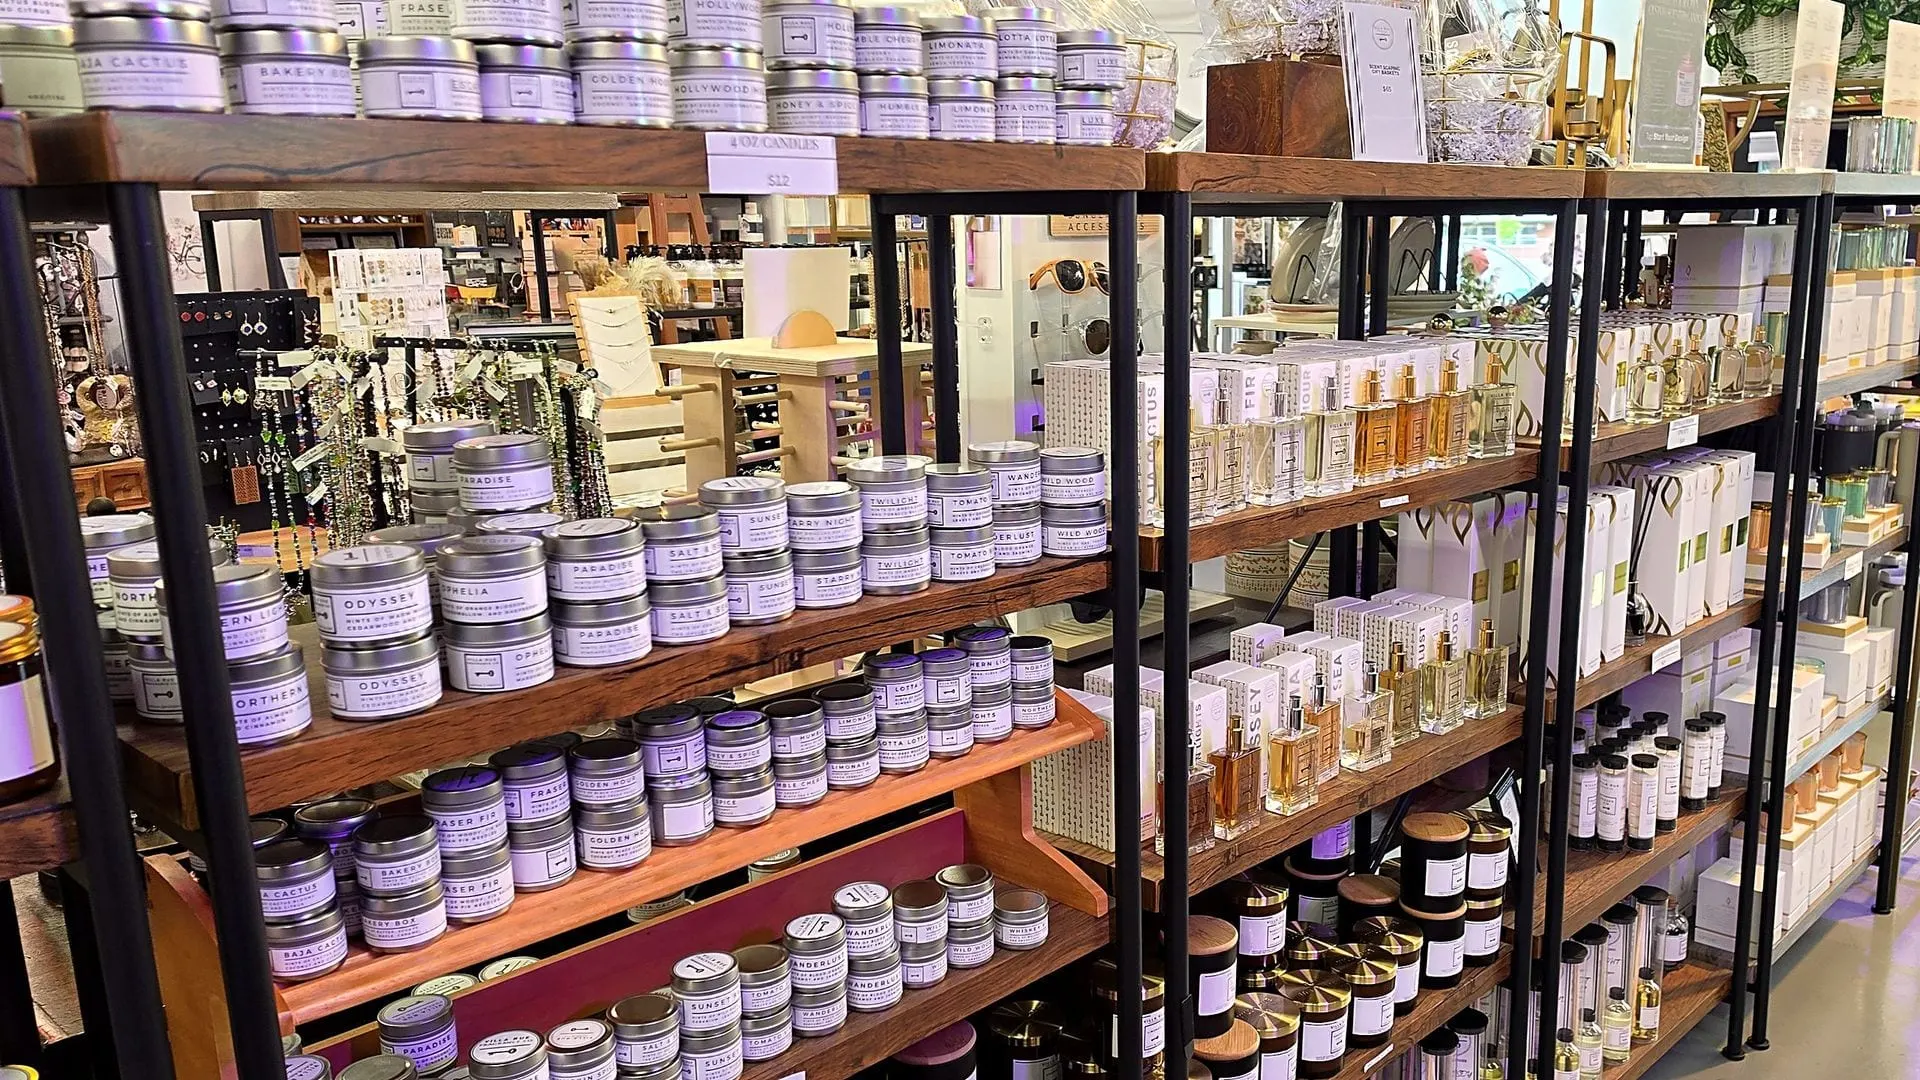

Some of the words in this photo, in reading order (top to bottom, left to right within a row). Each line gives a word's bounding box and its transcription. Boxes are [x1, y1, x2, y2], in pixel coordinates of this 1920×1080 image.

[401, 4, 446, 12] FRASE
[929, 42, 985, 50] LIMONATA
[111, 56, 188, 69] CACTUS
[260, 67, 325, 78] BAKERY
[592, 76, 644, 84] GOLDEN
[674, 85, 749, 93] HOLLYWOOD
[776, 100, 811, 109] HONEY
[731, 136, 738, 148] 4
[741, 136, 760, 148] OZ
[762, 137, 820, 150] CANDLES
[1675, 134, 1689, 144] Design
[767, 175, 791, 187] $12
[460, 475, 513, 485] PARADISE
[1066, 477, 1095, 485] WOOD
[871, 496, 918, 505] TWILIGHT
[952, 497, 988, 506] TOMATO
[825, 515, 855, 527] NIGHT
[670, 547, 699, 558] SALT
[950, 550, 987, 559] TOMATO
[573, 560, 633, 573] PARADISE
[878, 557, 924, 568] TWILIGHT
[817, 574, 854, 585] STARRY
[441, 584, 489, 596] OPHELIA
[343, 591, 415, 609] ODYSSEY
[670, 611, 700, 620] SALT
[347, 621, 400, 631] CEDARWOOD
[579, 624, 639, 639] PARADISE
[515, 647, 549, 662] OPHEL
[358, 672, 425, 691] ODYSSEY
[895, 683, 919, 693] LOTTA
[235, 686, 304, 709] ORTHERN
[245, 717, 287, 731] CINNAMON
[838, 713, 873, 725] LIMONATA
[738, 750, 761, 758] SPICE
[831, 761, 870, 770] LIMONATA
[434, 818, 473, 828] RASER
[479, 811, 497, 823] FIR
[590, 835, 630, 844] GOLDEN
[381, 863, 421, 876] BAKERY
[273, 884, 318, 899] CACTUS
[444, 885, 475, 894] ASER
[482, 879, 499, 890] FIR
[394, 918, 417, 926] BOX
[1009, 925, 1041, 934] WHISKEY
[284, 948, 313, 959] BAJA
[751, 986, 784, 998] TOMATO
[692, 997, 731, 1011] SUNSET
[402, 1034, 452, 1055] PARADISE
[484, 1036, 509, 1044] VILLA
[749, 1034, 783, 1047] TOMATO
[642, 1041, 663, 1051] SALT
